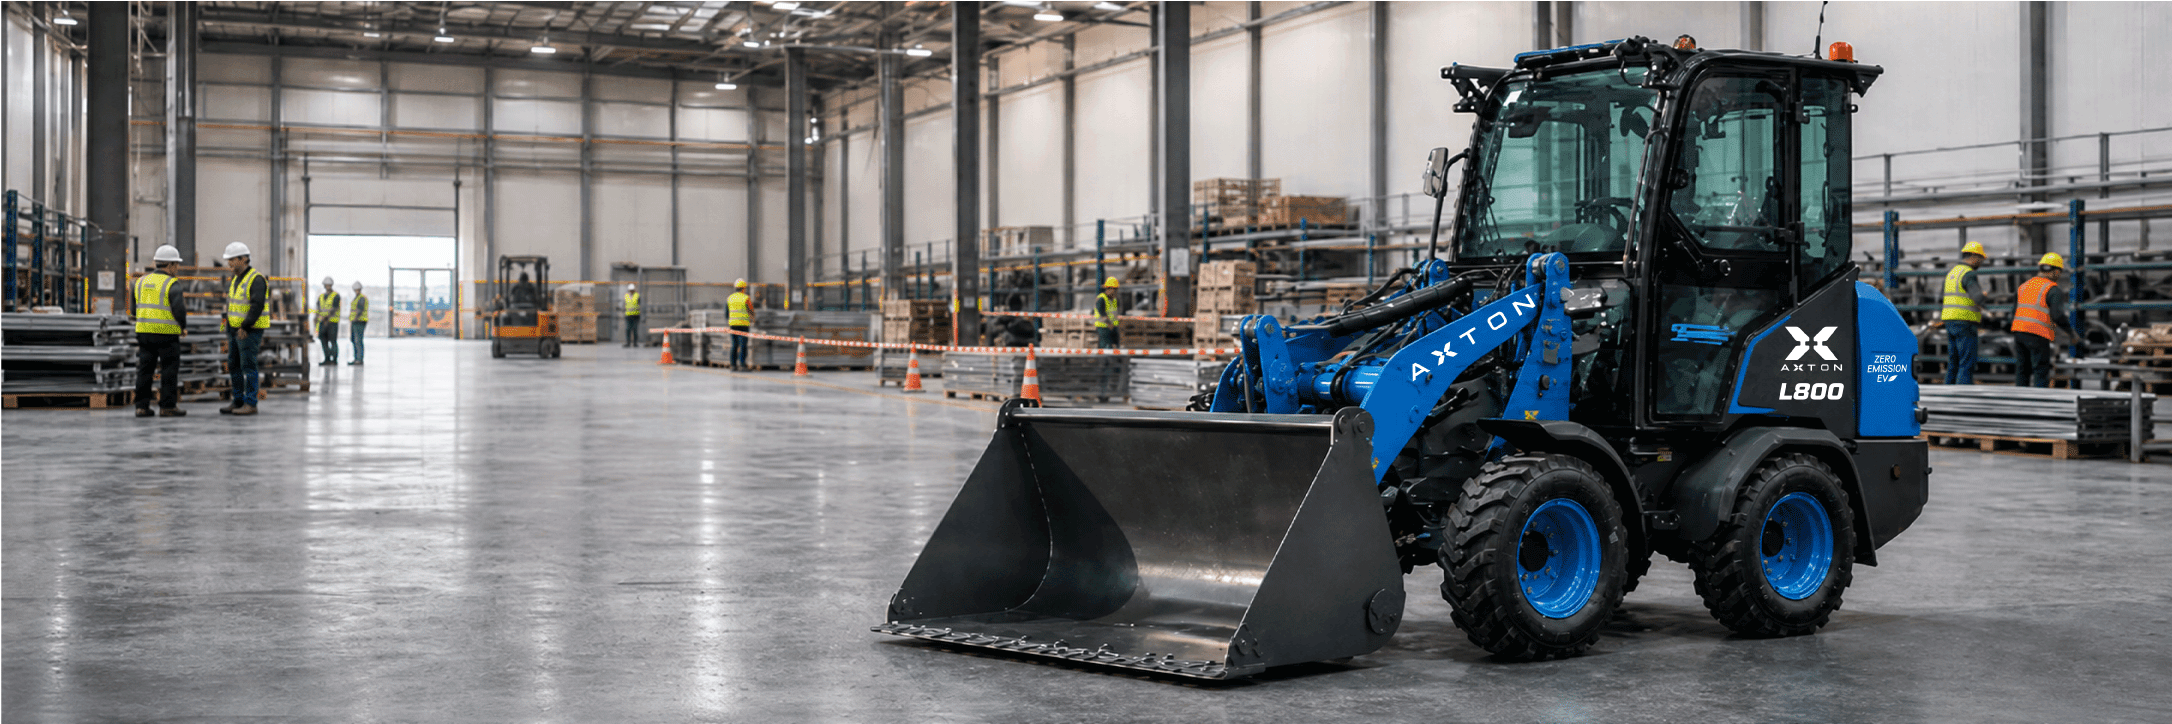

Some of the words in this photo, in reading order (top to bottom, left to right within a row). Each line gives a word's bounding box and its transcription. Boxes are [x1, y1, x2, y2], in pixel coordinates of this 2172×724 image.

[1411, 294, 1536, 381] AXTON
[1874, 354, 1897, 363] ZERO
[1867, 364, 1908, 372] EMISSION
[1876, 374, 1889, 382] EV
[1779, 383, 1845, 400] L800
